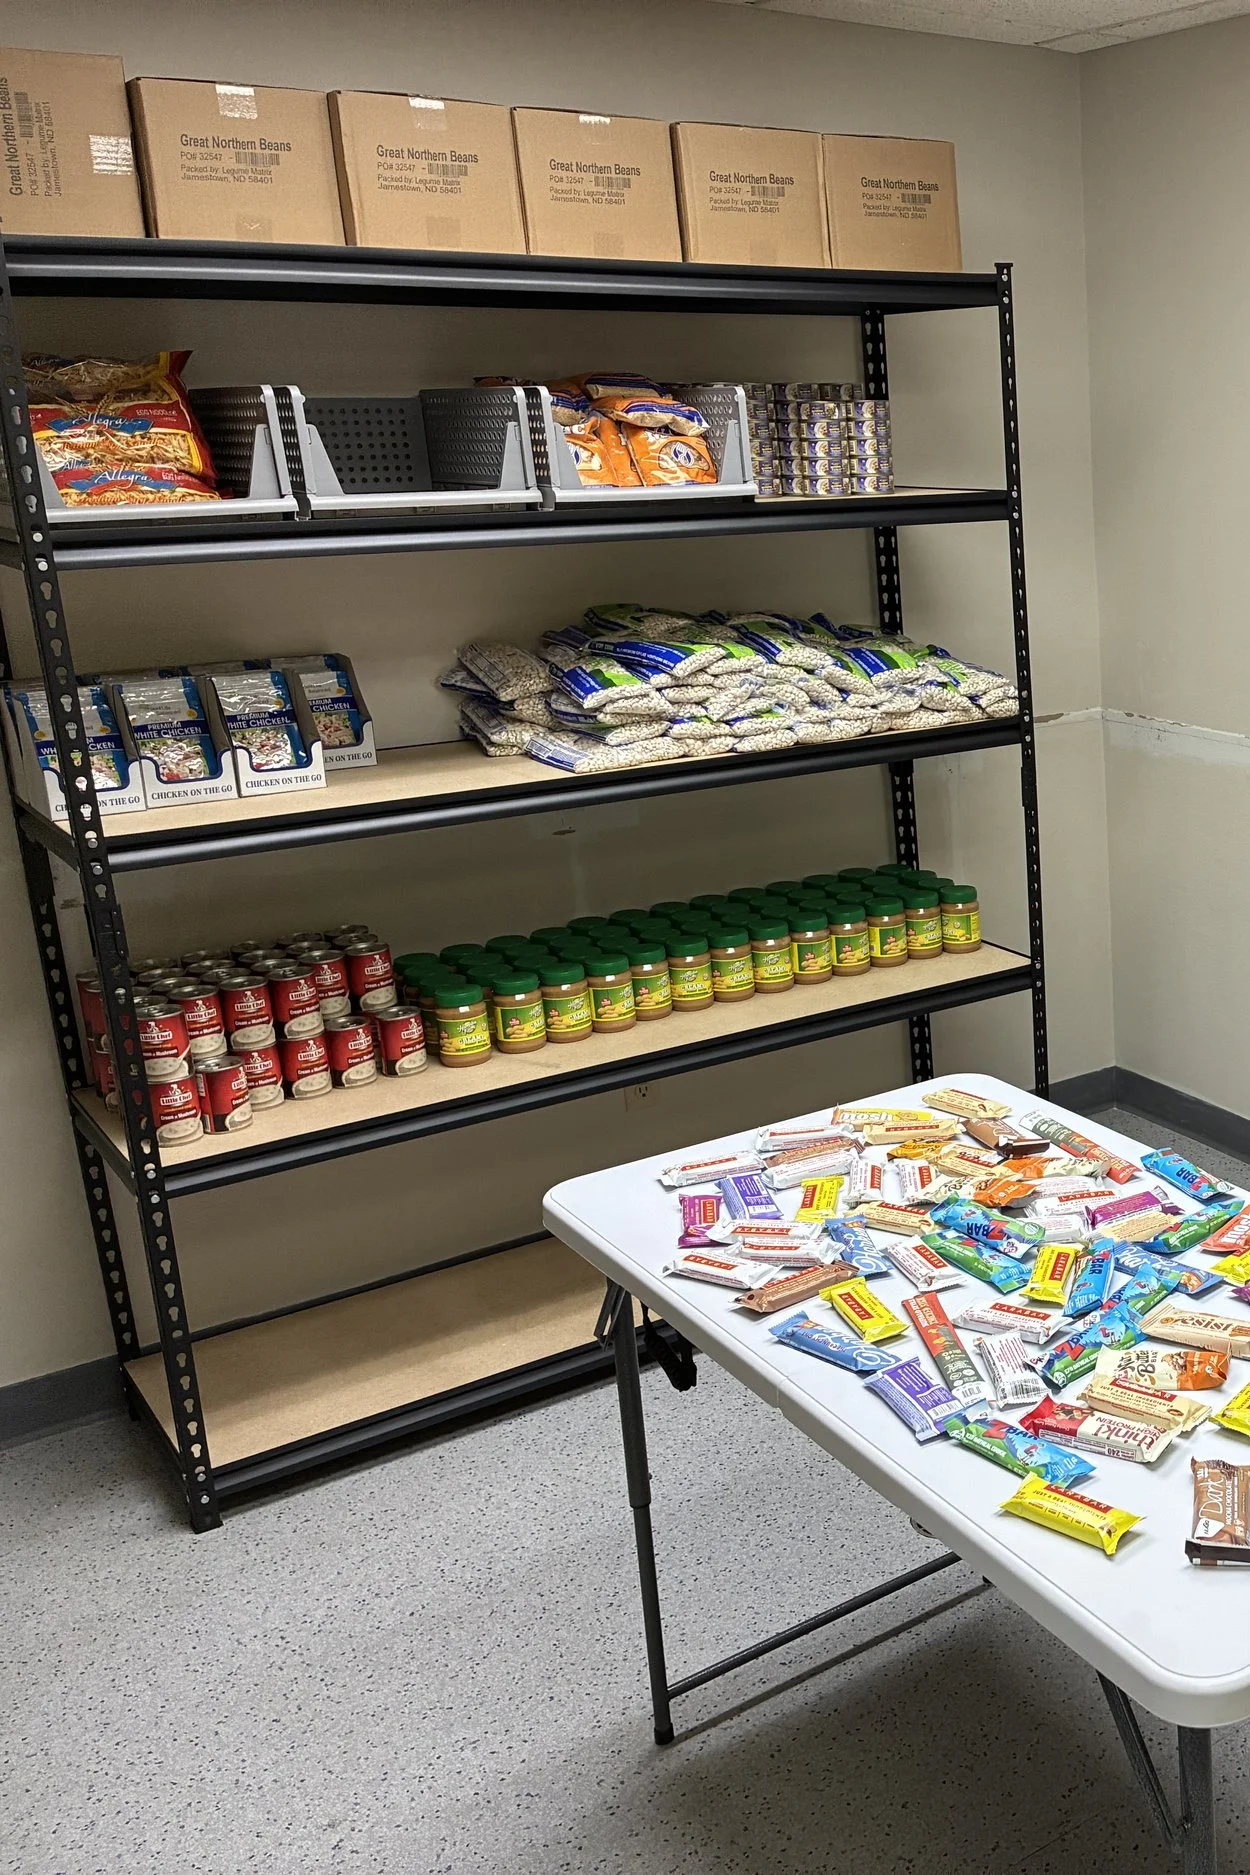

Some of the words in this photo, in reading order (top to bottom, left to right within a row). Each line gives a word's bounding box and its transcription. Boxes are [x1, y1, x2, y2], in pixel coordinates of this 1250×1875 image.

[2, 113, 20, 163] Northern
[180, 133, 209, 149] Great
[212, 136, 257, 150] Northern
[259, 138, 292, 152] Beans
[199, 153, 223, 161] 32547
[376, 144, 405, 159] Great
[407, 147, 447, 162] Northern
[450, 150, 479, 164] Beans
[181, 164, 208, 173] Packed
[395, 163, 416, 173] 32547
[549, 159, 574, 173] Great
[575, 161, 612, 175] Northern
[614, 163, 641, 177] Beans
[9, 165, 23, 196] Great
[181, 173, 231, 184] Jamestown,
[233, 175, 246, 183] ND
[248, 175, 273, 184] 58401
[377, 174, 403, 183] Packed
[709, 170, 732, 184] Great
[733, 172, 767, 185] Northern
[769, 173, 795, 186] Beans
[860, 176, 882, 189] Great
[883, 178, 916, 191] Northern
[917, 180, 940, 192] Beans
[440, 186, 462, 194] 58401
[94, 470, 151, 490] Allegra
[312, 702, 350, 712] CHICKEN
[236, 712, 270, 720] PREMIUM
[147, 722, 182, 731] PREMIUM
[160, 727, 202, 738] CHICKEN
[335, 753, 346, 762] ON
[347, 752, 361, 761] THE
[362, 751, 373, 760] GO
[245, 777, 281, 789] CHICKEN
[282, 776, 293, 785] ON
[294, 775, 311, 784] THE
[311, 774, 322, 782] GO
[151, 789, 189, 801] CHICKEN
[190, 788, 203, 797] ON
[204, 786, 220, 796] THE
[221, 785, 233, 793] GO
[109, 797, 127, 807] THE
[128, 796, 140, 804] GO
[1061, 1191, 1111, 1200] LARABAR
[841, 1294, 870, 1319] LARABAR
[995, 1303, 1046, 1319] LARABAR
[1174, 1317, 1233, 1332] resist
[1096, 1416, 1141, 1432] PROTEIN
[1092, 1424, 1156, 1450] think!
[1050, 1485, 1108, 1510] LARABAR
[1198, 1477, 1224, 1518] Dark
